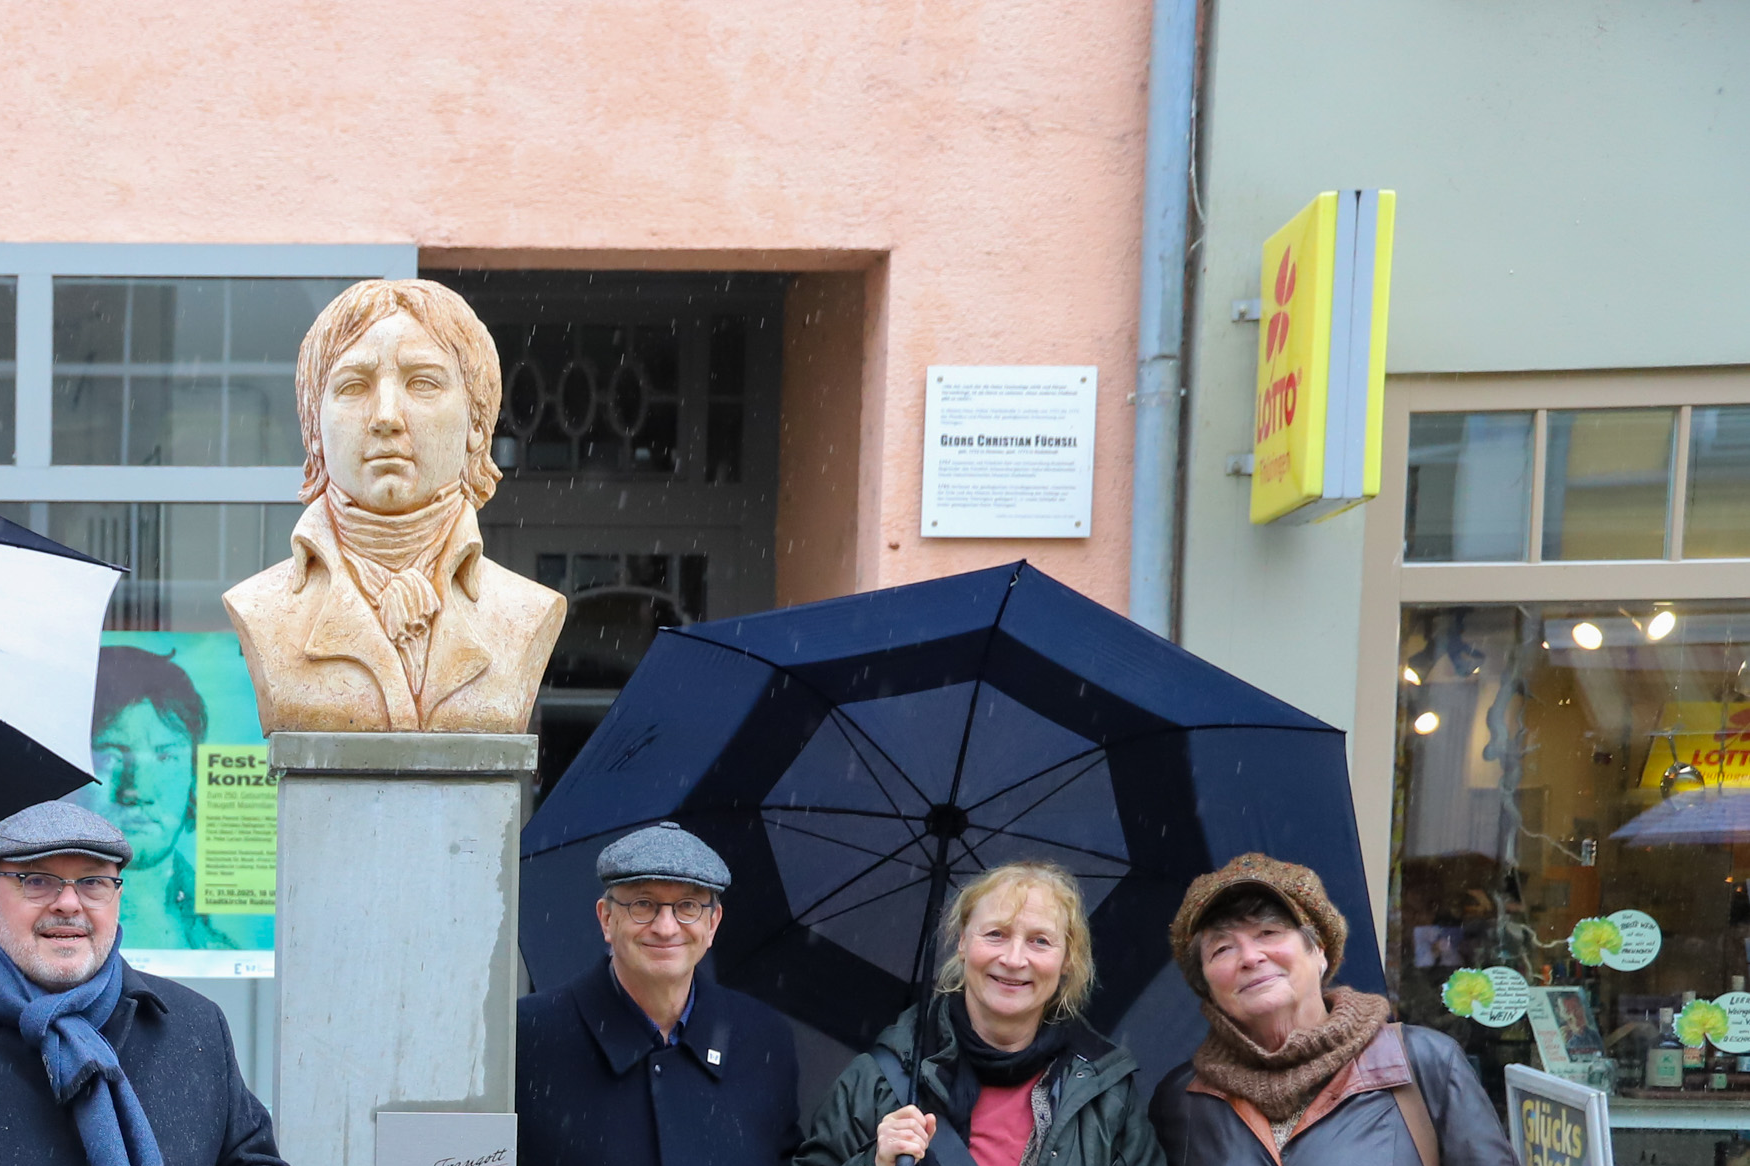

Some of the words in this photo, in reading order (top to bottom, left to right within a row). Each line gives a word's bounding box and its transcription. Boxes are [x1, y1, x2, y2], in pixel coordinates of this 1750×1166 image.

[1257, 371, 1297, 444] LOTTO
[941, 434, 974, 447] GEORG
[977, 434, 1031, 447] CHRISTIAN
[1035, 434, 1078, 447] FÜCHSEL
[208, 754, 267, 768] Fest-
[1691, 749, 1750, 766] LOTT
[1522, 1099, 1582, 1158] Glücks
